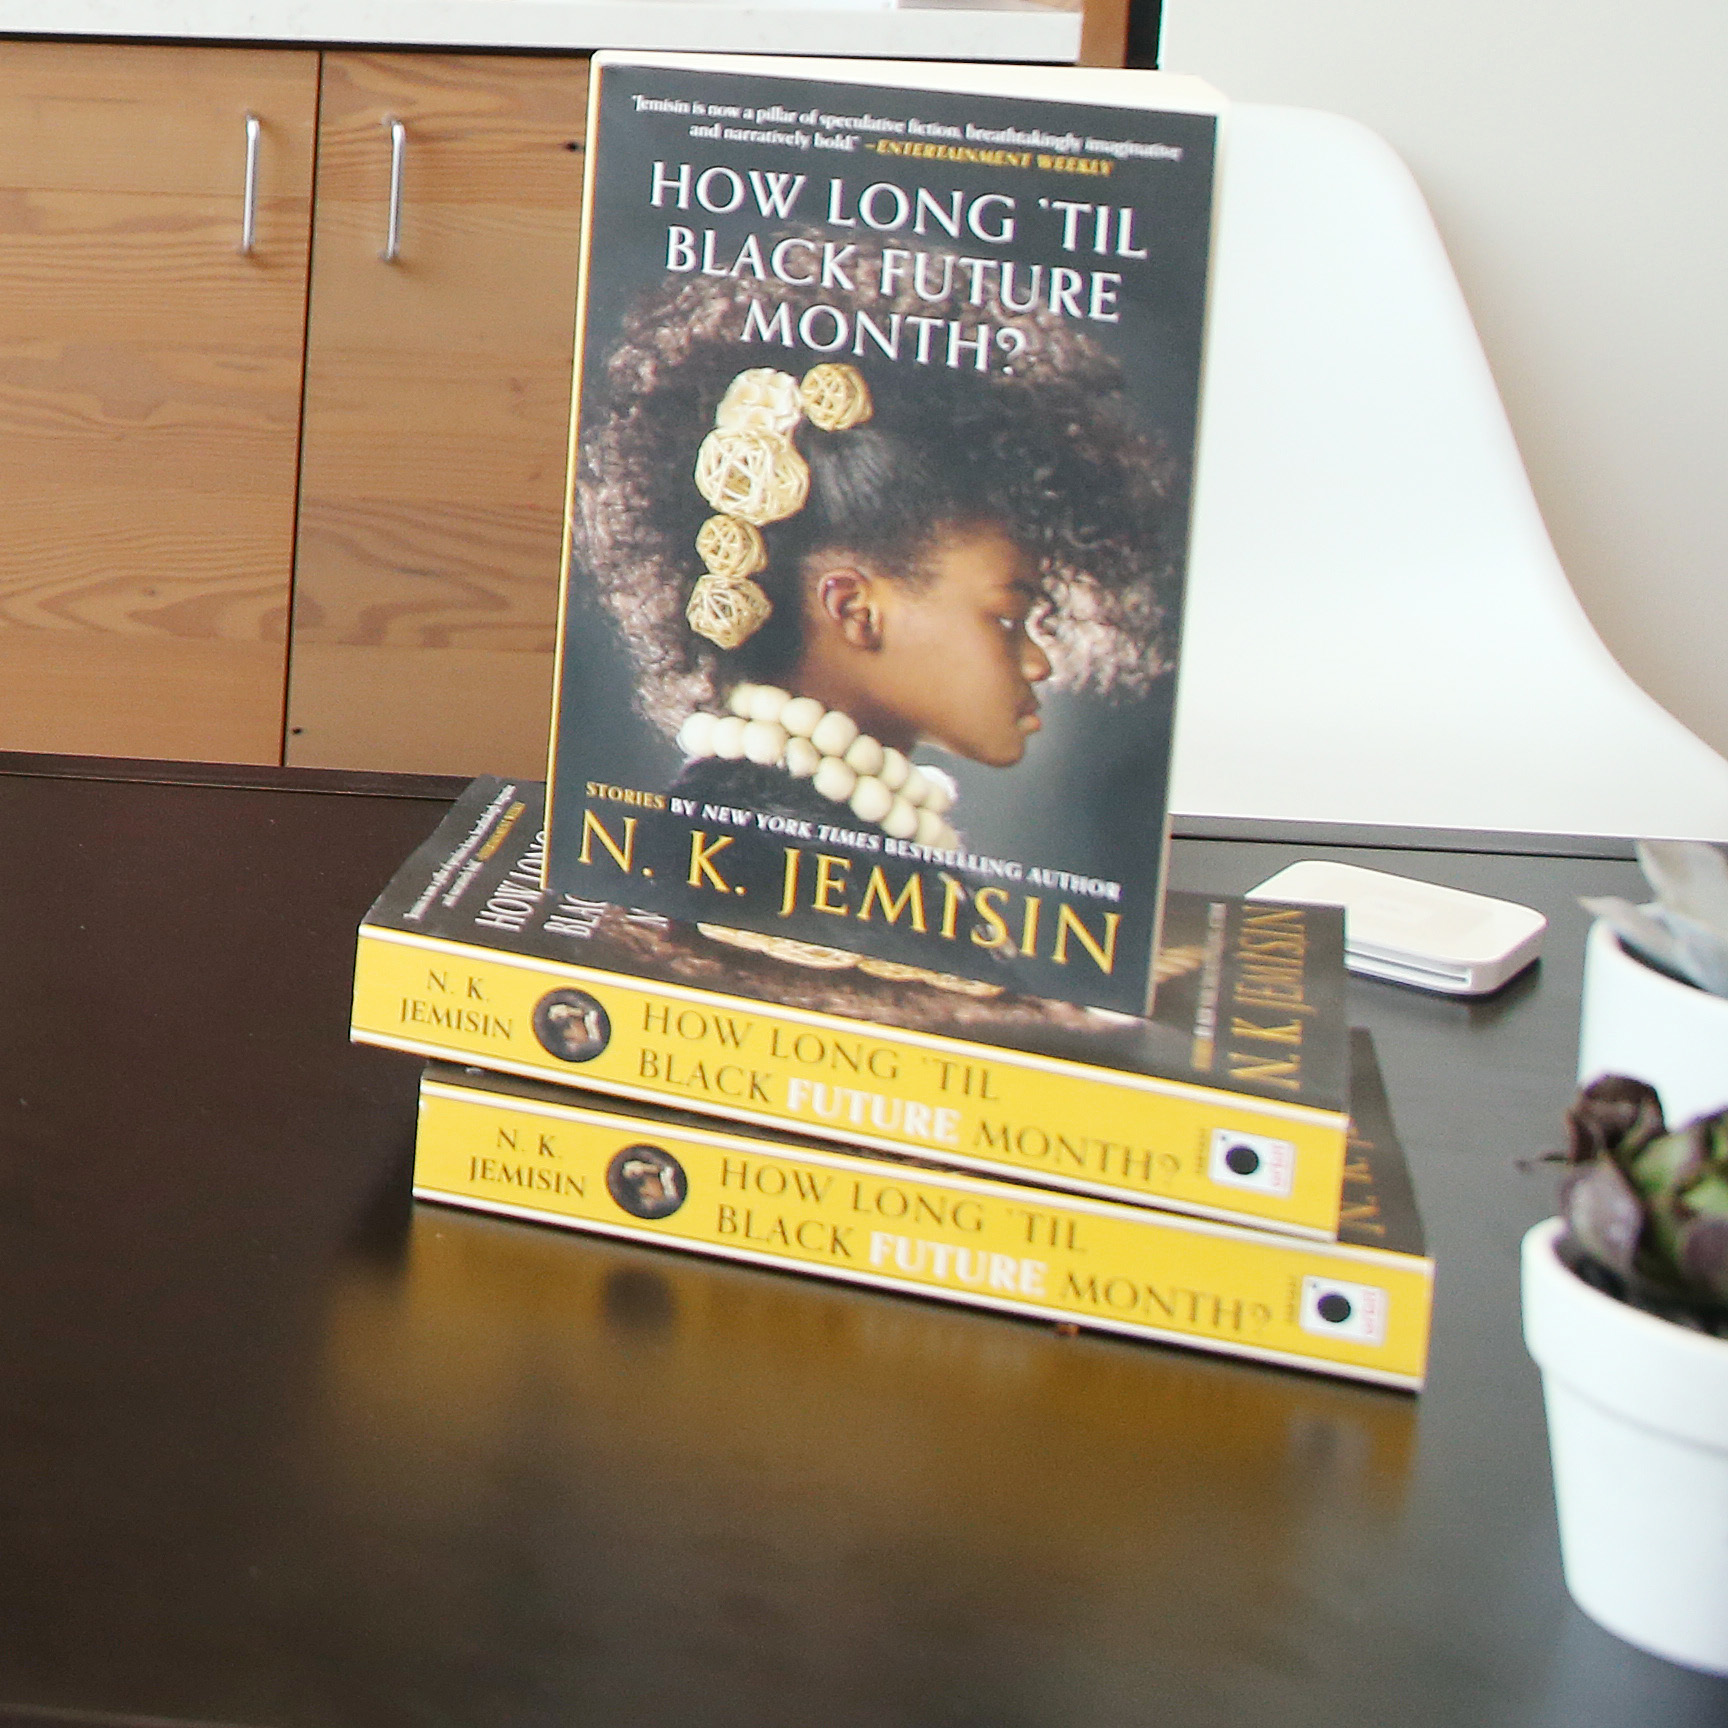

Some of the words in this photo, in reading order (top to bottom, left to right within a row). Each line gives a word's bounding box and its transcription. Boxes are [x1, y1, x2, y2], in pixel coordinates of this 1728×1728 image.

[650, 160, 807, 220] HOW
[827, 177, 1017, 244] LONG
[1038, 196, 1148, 260] 'TIL
[665, 225, 856, 291] BLACK
[880, 248, 1123, 323] FUTURE
[740, 299, 1029, 374] MONTH?
[586, 781, 665, 810] STORIES
[670, 797, 697, 816] BY
[701, 803, 752, 826] NEW
[756, 812, 811, 840] YORK
[817, 824, 880, 851] TIMES
[884, 837, 1023, 880] BESTSELLING
[1026, 867, 1122, 902] AUTHOR
[578, 809, 653, 877] N.
[687, 830, 746, 896] K.
[777, 847, 1123, 975] JEMISIN
[400, 997, 514, 1040] JEMISIN
[427, 969, 455, 994] N.
[467, 979, 489, 1002] K.
[642, 1002, 755, 1050] HOW
[772, 1028, 898, 1081] LONG
[923, 1056, 1000, 1101] 'TIL
[496, 1129, 526, 1153] N.
[538, 1134, 562, 1159] K.
[639, 1048, 775, 1104] BLACK
[787, 1077, 962, 1145] FUTURE
[973, 1121, 1182, 1185] MONTH?
[469, 1157, 586, 1198] JEMISIN
[720, 1158, 833, 1204] HOW
[852, 1182, 984, 1234] LONG
[1005, 1211, 1088, 1254] 'TIL
[717, 1203, 854, 1260] BLACK
[868, 1231, 1046, 1297] FUTURE
[1061, 1272, 1273, 1335] MONTH?
